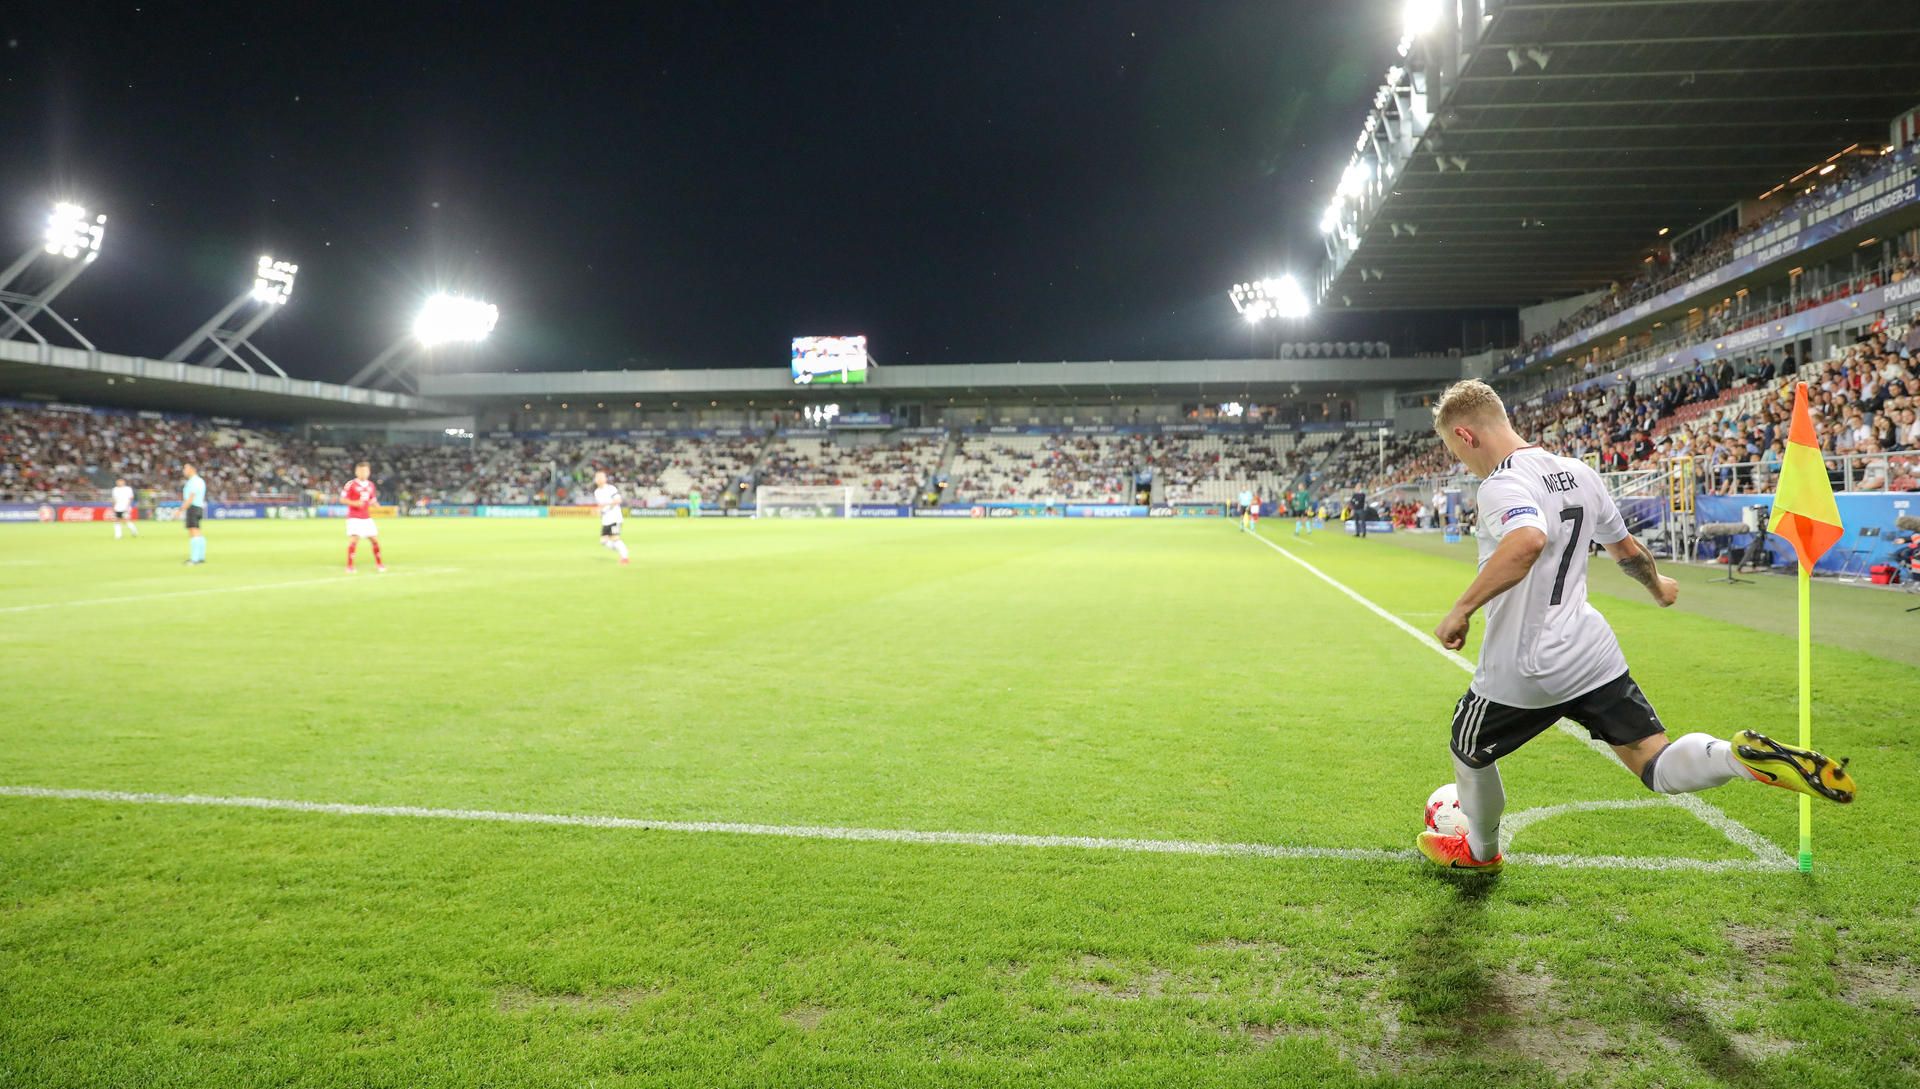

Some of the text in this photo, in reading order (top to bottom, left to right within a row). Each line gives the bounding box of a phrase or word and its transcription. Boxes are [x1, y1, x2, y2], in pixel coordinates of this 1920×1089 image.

[1853, 184, 1916, 222] UEFA UNDER-21
[1757, 243, 1782, 263] POLAND
[1884, 279, 1920, 302] POLAND
[1094, 507, 1132, 517] RESPECT
[1549, 506, 1584, 606] 7
